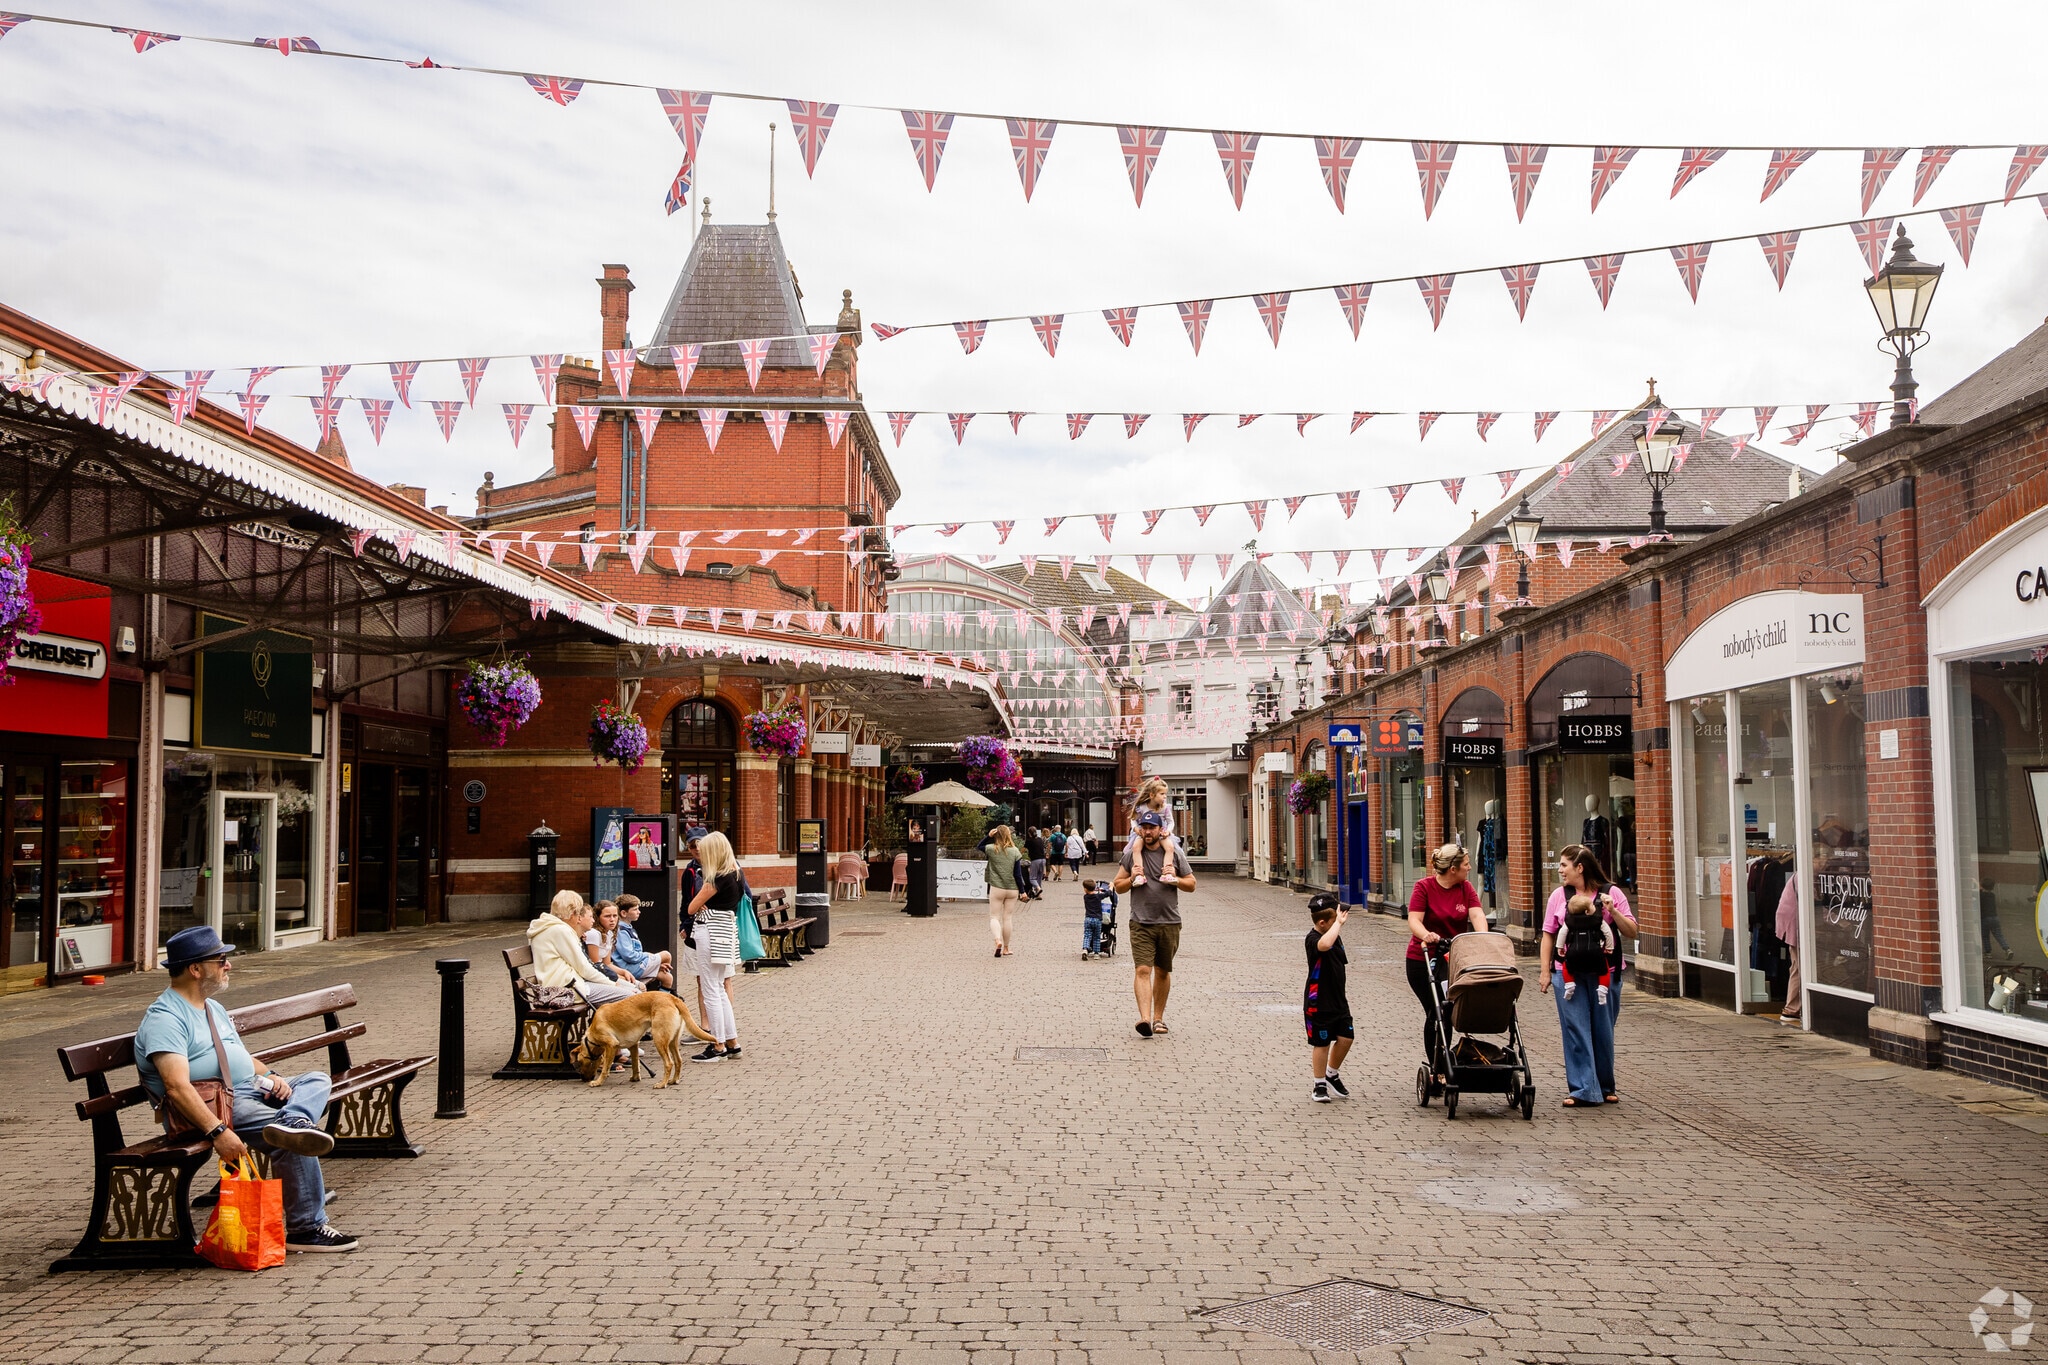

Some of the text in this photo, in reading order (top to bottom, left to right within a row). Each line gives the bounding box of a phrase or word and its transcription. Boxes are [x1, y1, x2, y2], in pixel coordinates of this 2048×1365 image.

[1808, 612, 1851, 634] nc
[1722, 620, 1787, 659] nobody's child
[1804, 638, 1857, 649] nobody's child
[15, 639, 97, 669] CREUSET
[243, 708, 278, 728] PAEONIA
[1568, 724, 1622, 737] HOBBS
[1236, 744, 1246, 756] K
[1452, 743, 1496, 755] HOBBS
[1818, 874, 1836, 895] THE
[1826, 890, 1868, 939] Society
